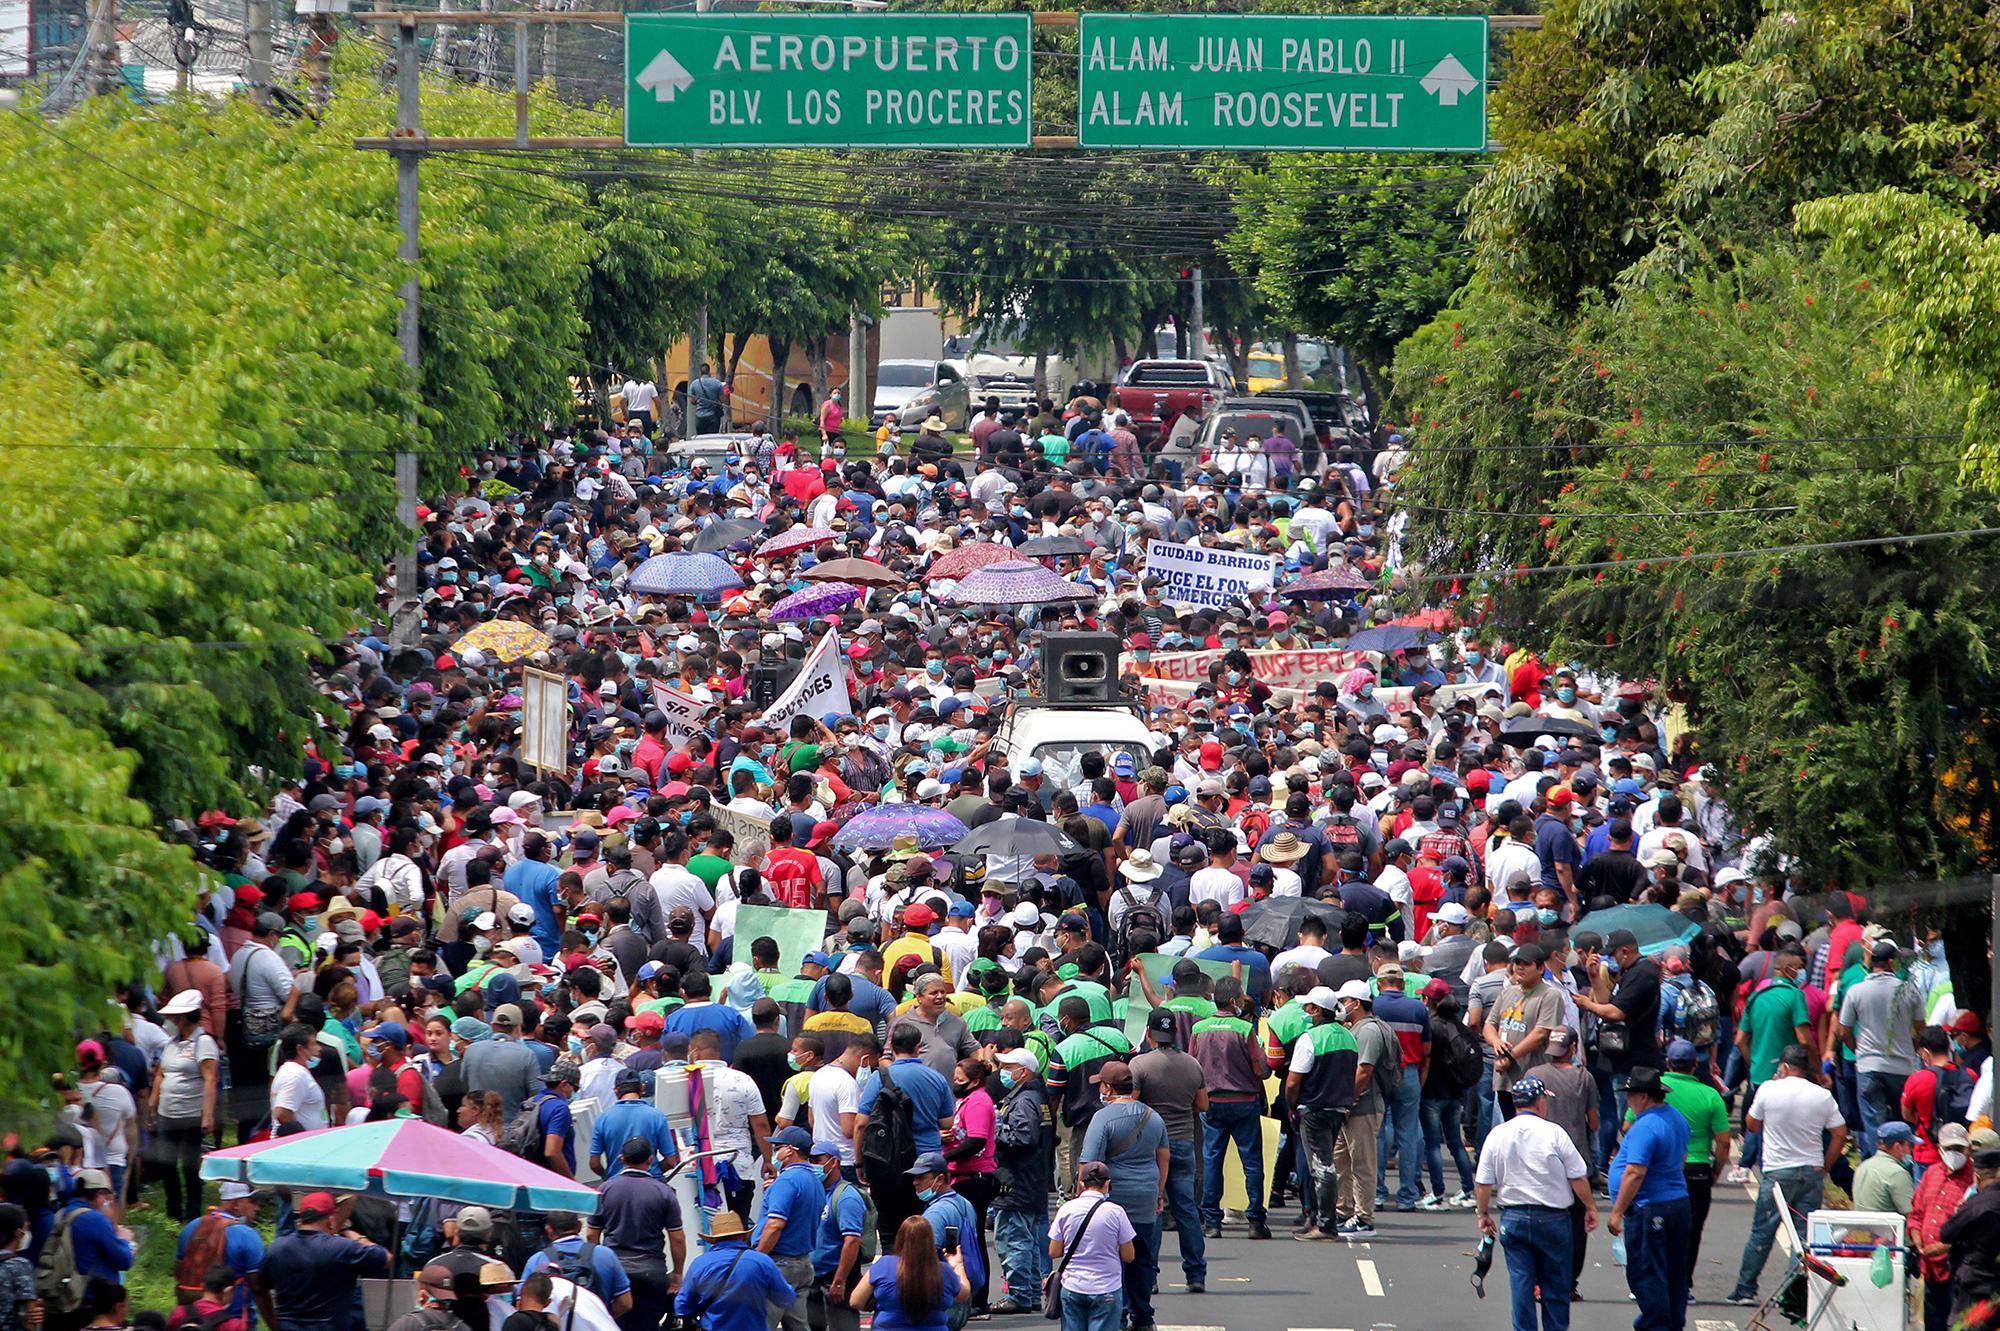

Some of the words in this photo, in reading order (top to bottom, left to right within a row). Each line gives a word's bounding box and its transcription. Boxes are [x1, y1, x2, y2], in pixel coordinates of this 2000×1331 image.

[714, 35, 1019, 71] AEROPUERTO
[1088, 36, 1175, 71] ALAM.
[1190, 36, 1263, 72] JUAN
[1282, 38, 1371, 74] PABLO
[1390, 39, 1405, 74] II
[709, 90, 762, 125] BLV.
[787, 89, 841, 125] LOS
[866, 89, 1022, 125] PROCERES
[1089, 91, 1189, 126] ALAM.
[1213, 91, 1404, 128] ROOSEVELT
[1153, 545, 1204, 563] CIUDAD
[1207, 553, 1271, 571] BARRIOS
[1196, 574, 1215, 590] EL
[666, 700, 690, 718] SR.
